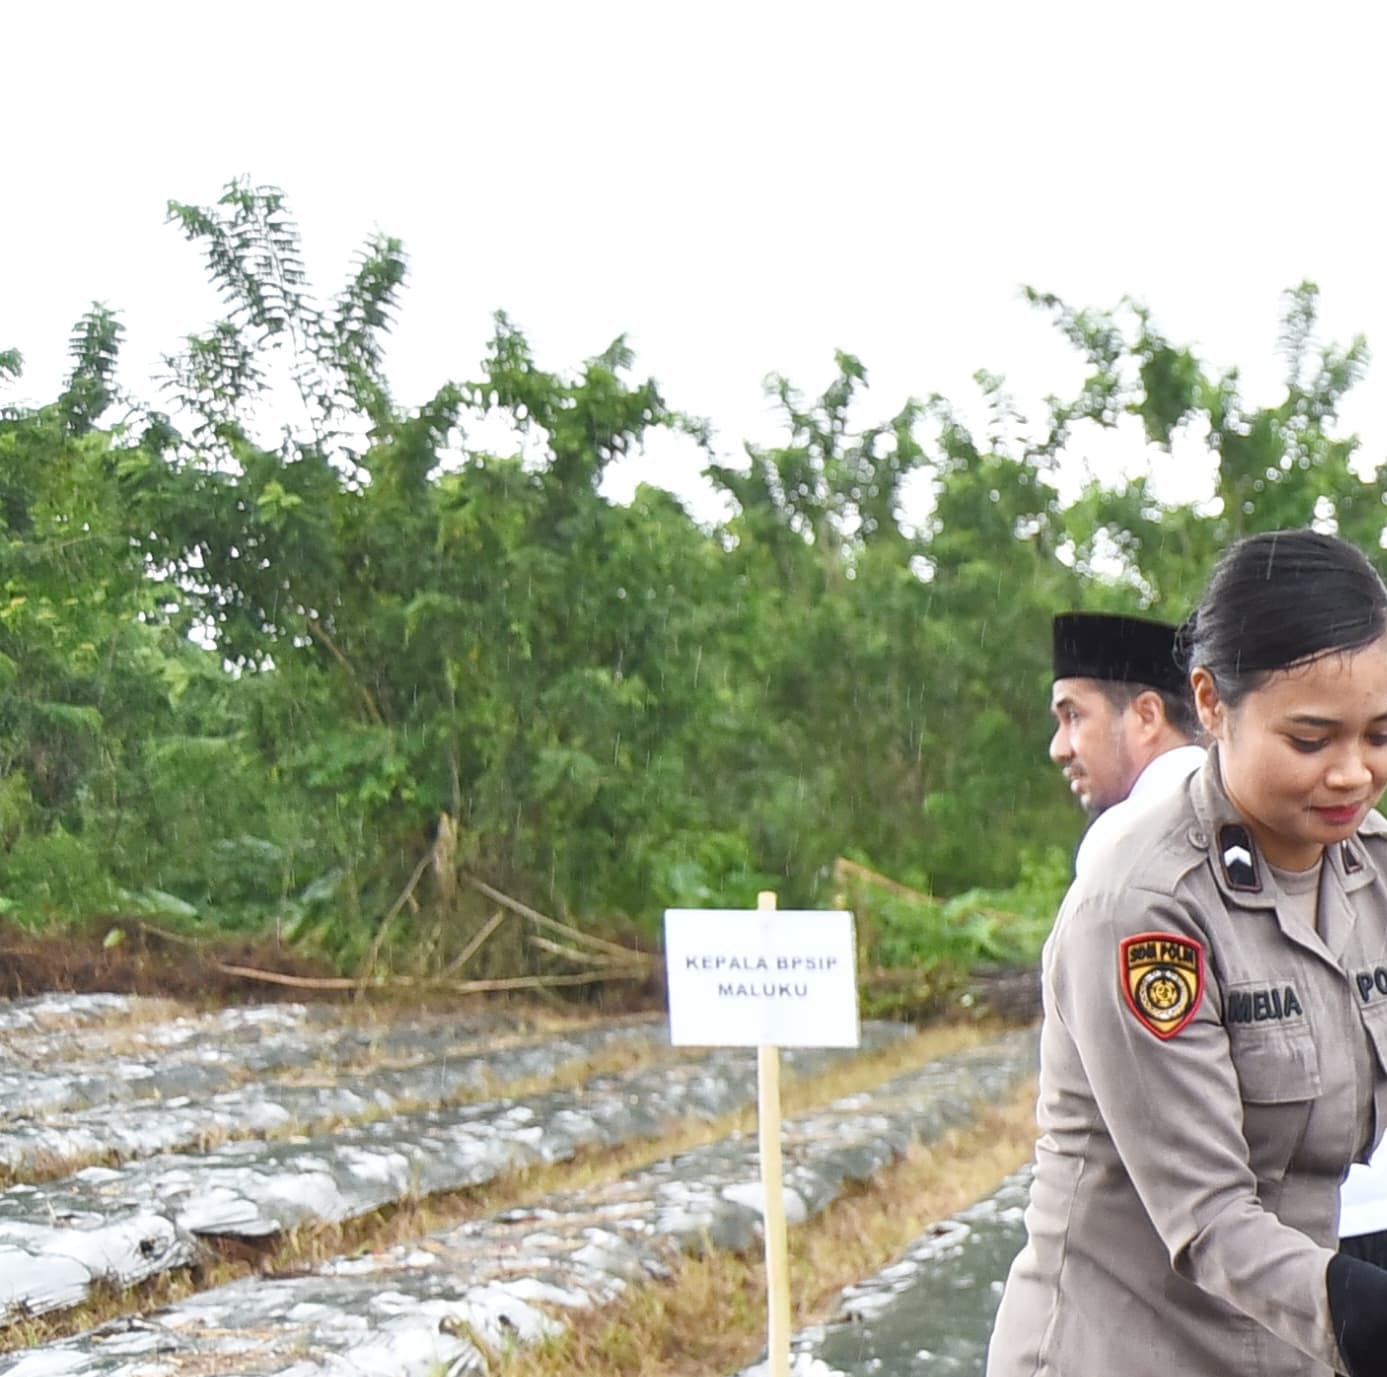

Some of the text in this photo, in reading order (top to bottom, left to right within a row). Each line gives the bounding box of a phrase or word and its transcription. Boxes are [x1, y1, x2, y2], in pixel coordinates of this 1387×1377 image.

[685, 956, 838, 971] KEPALA BPSIP
[717, 982, 808, 998] MALUKU
